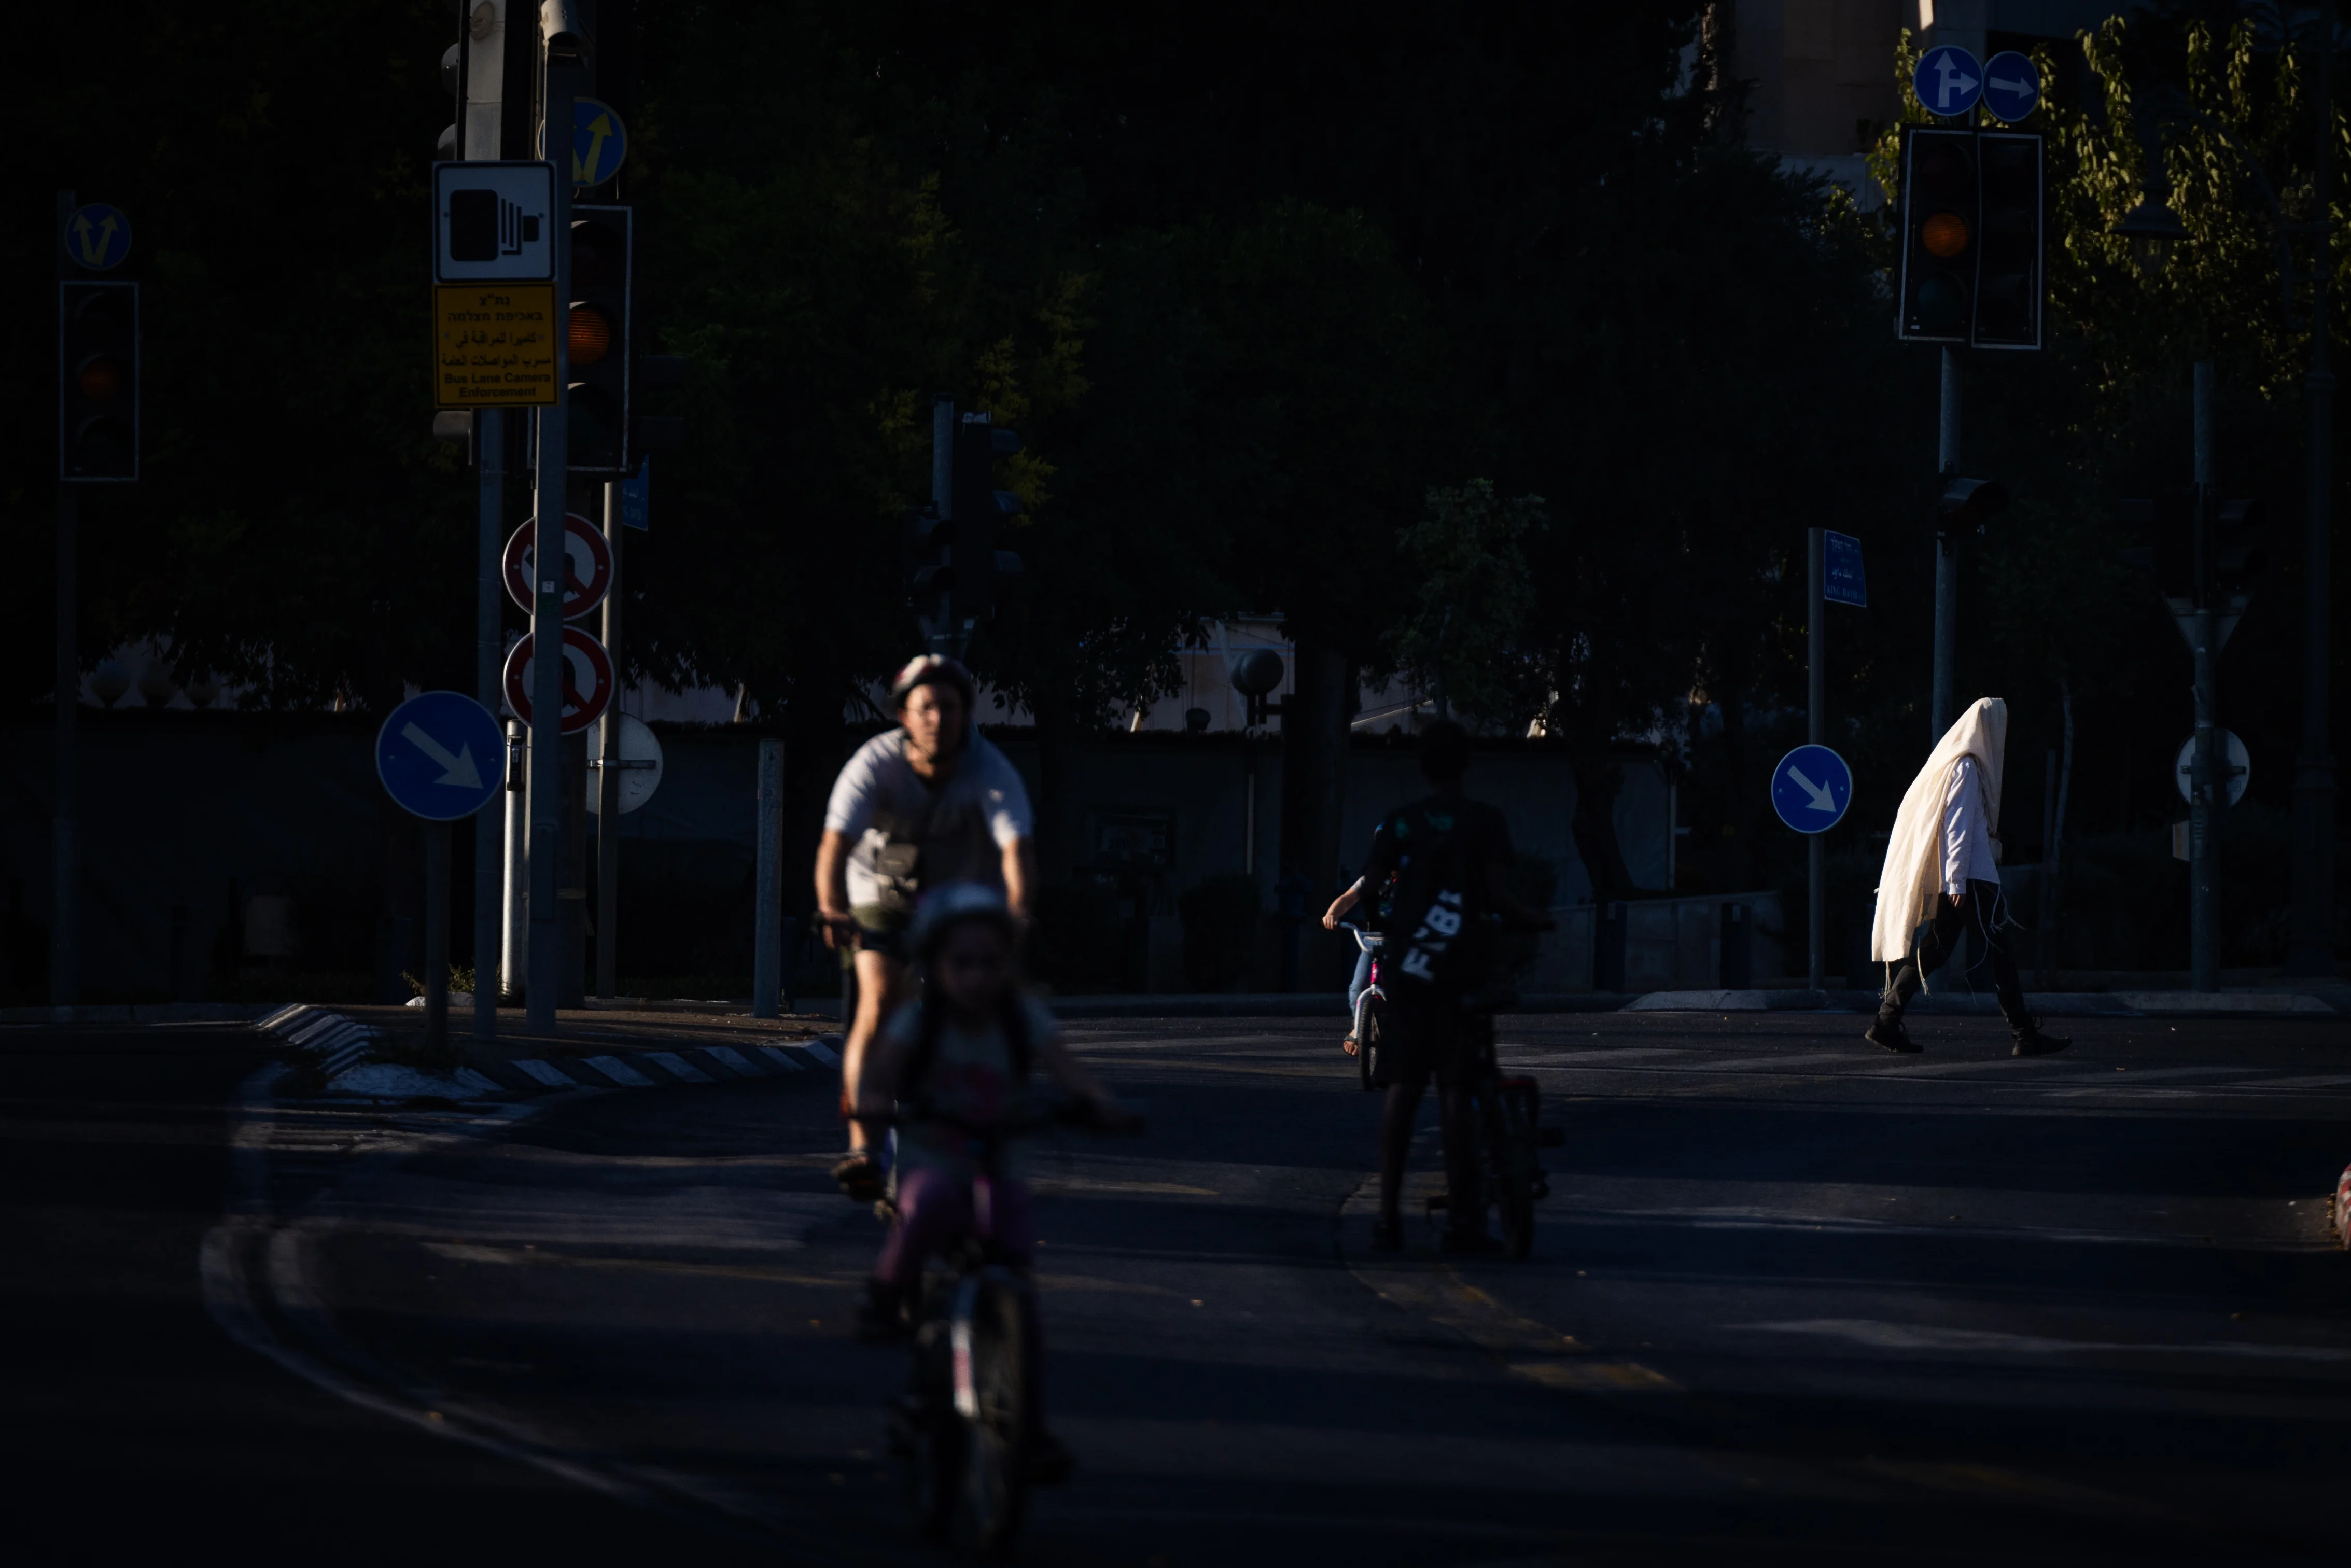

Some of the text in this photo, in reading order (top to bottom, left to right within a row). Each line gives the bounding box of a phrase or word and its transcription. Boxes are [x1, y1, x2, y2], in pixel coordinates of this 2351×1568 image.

[447, 310, 543, 321] באכיפת מצלמה
[445, 372, 551, 384] Bus Lane Camera
[459, 386, 537, 398] Enforcement
